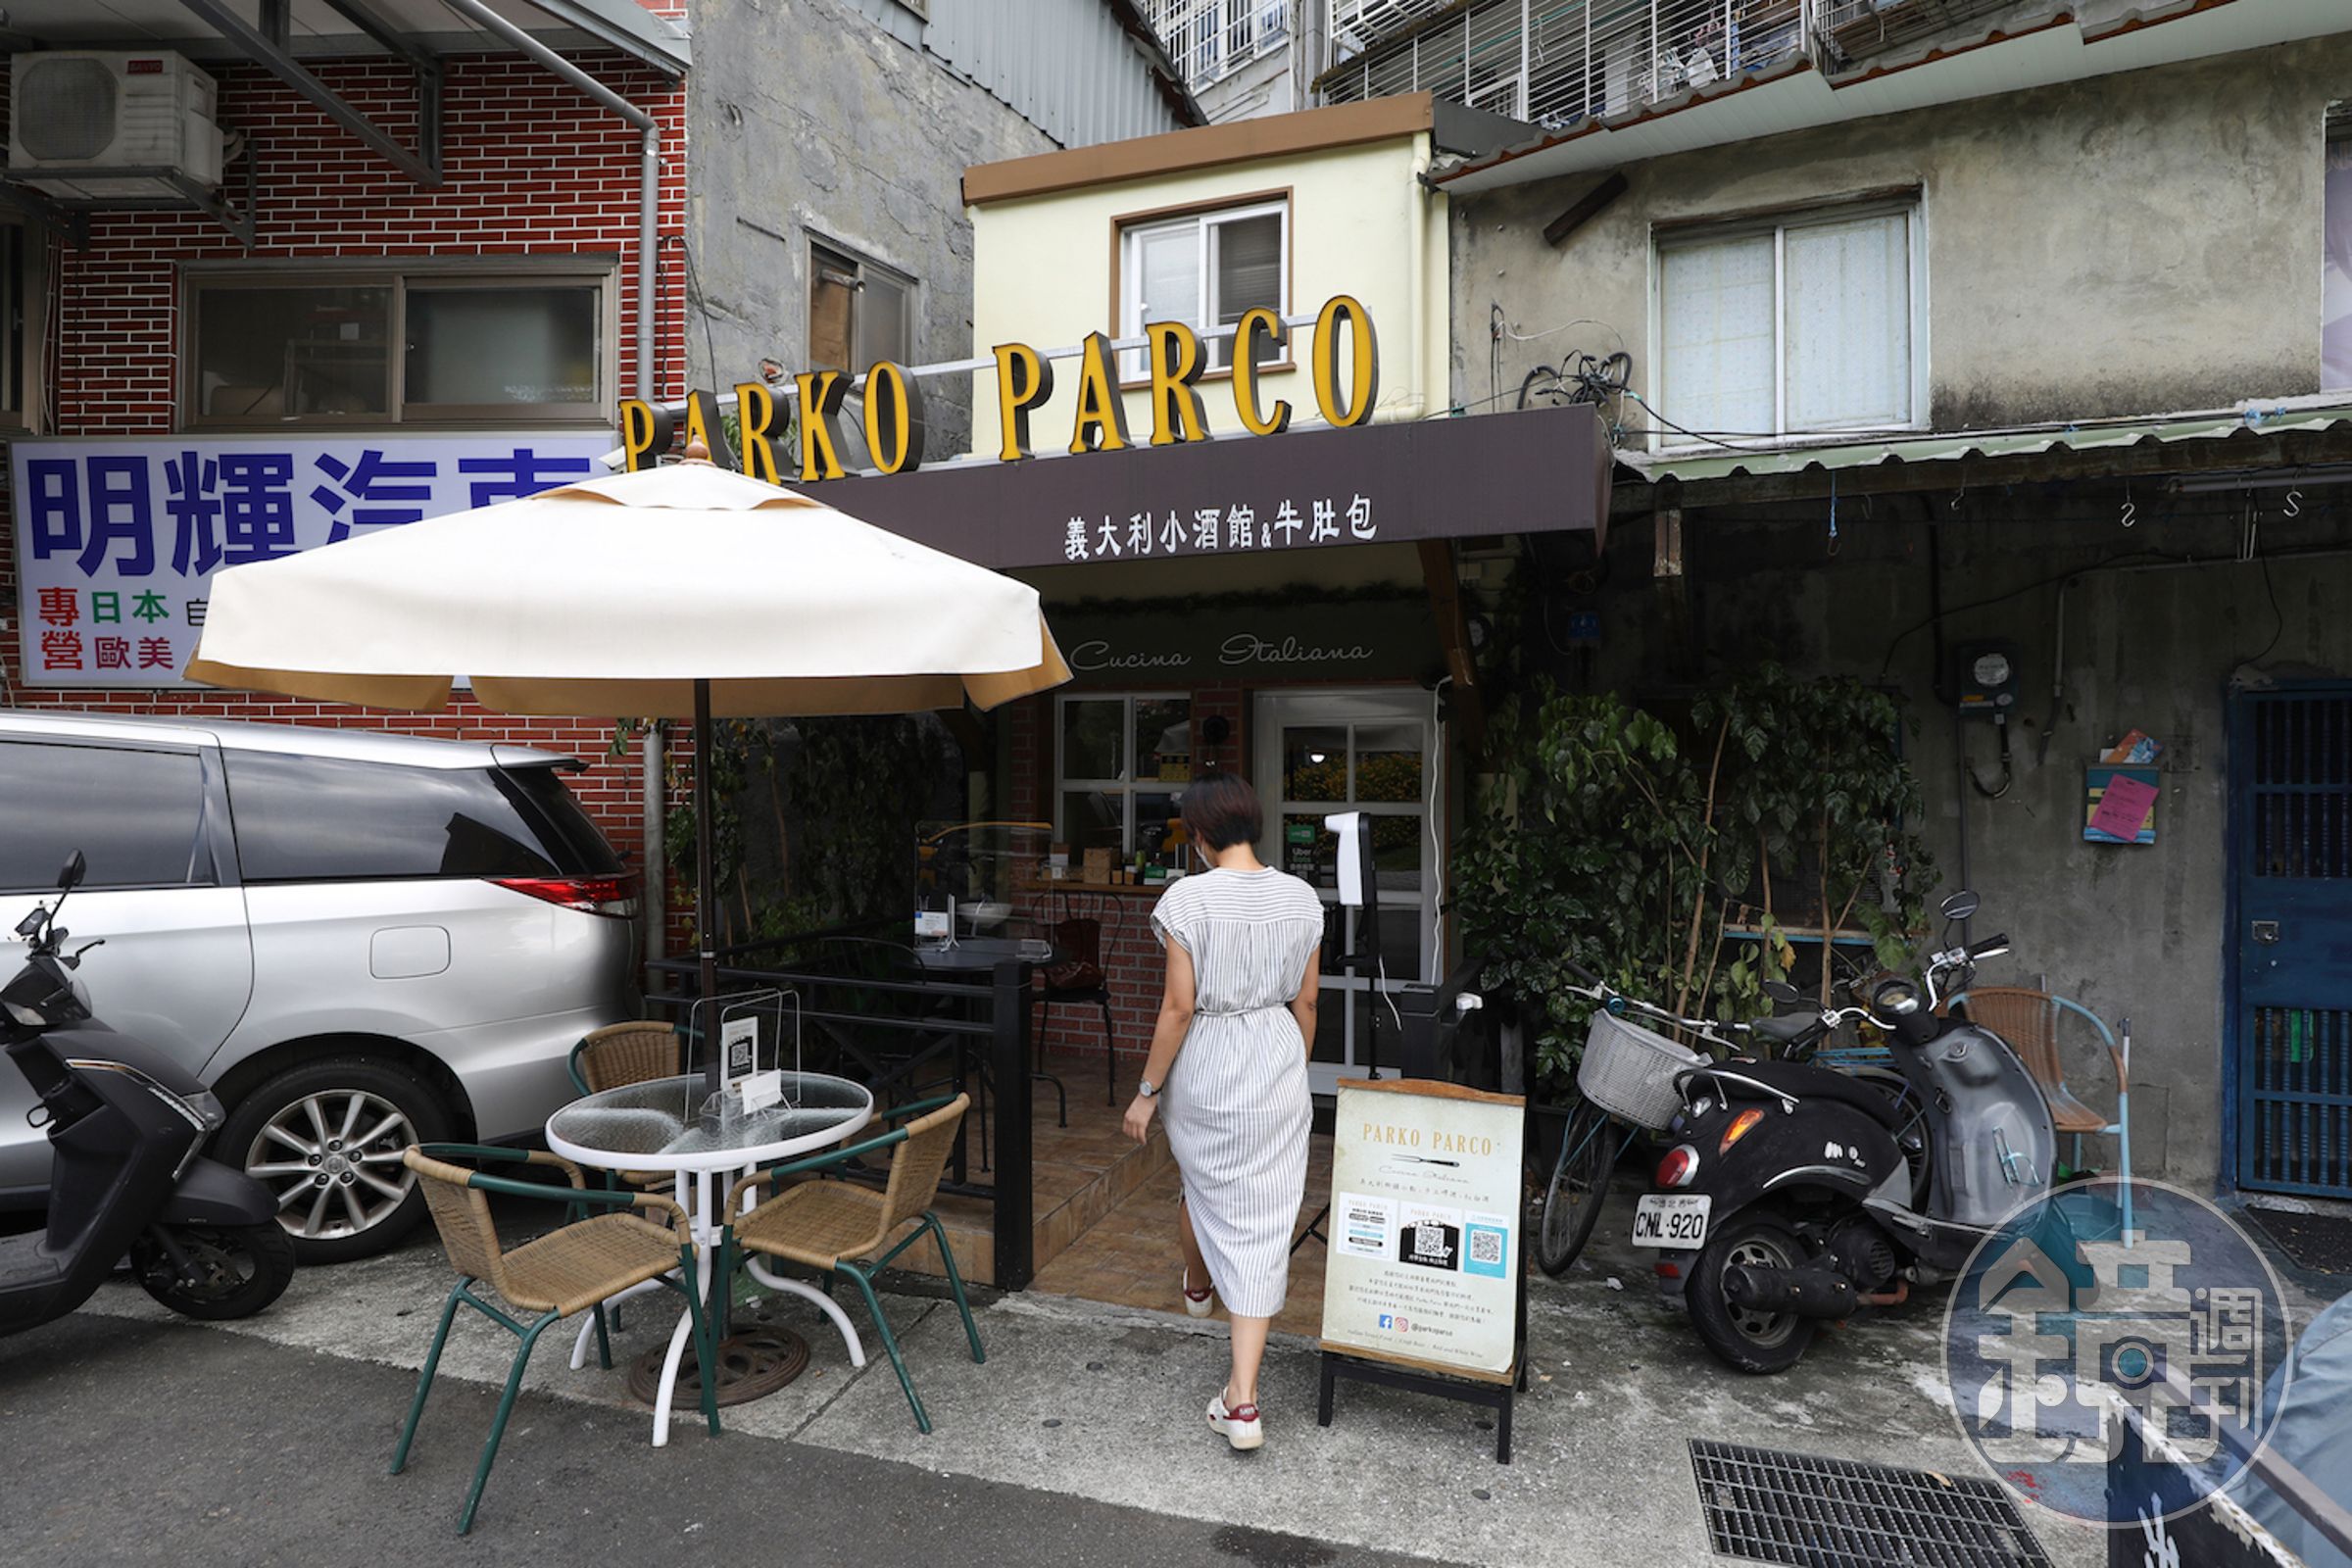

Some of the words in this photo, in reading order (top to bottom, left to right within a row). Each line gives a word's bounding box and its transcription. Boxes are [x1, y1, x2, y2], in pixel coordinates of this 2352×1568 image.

[619, 360, 924, 487] PARKO
[992, 294, 1380, 462] PARCO
[94, 636, 174, 670] 歐美
[1070, 640, 1192, 670] Cucina
[1218, 633, 1373, 667] Italiana
[1363, 1122, 1420, 1147] PARKO
[1433, 1131, 1492, 1156] PARCO
